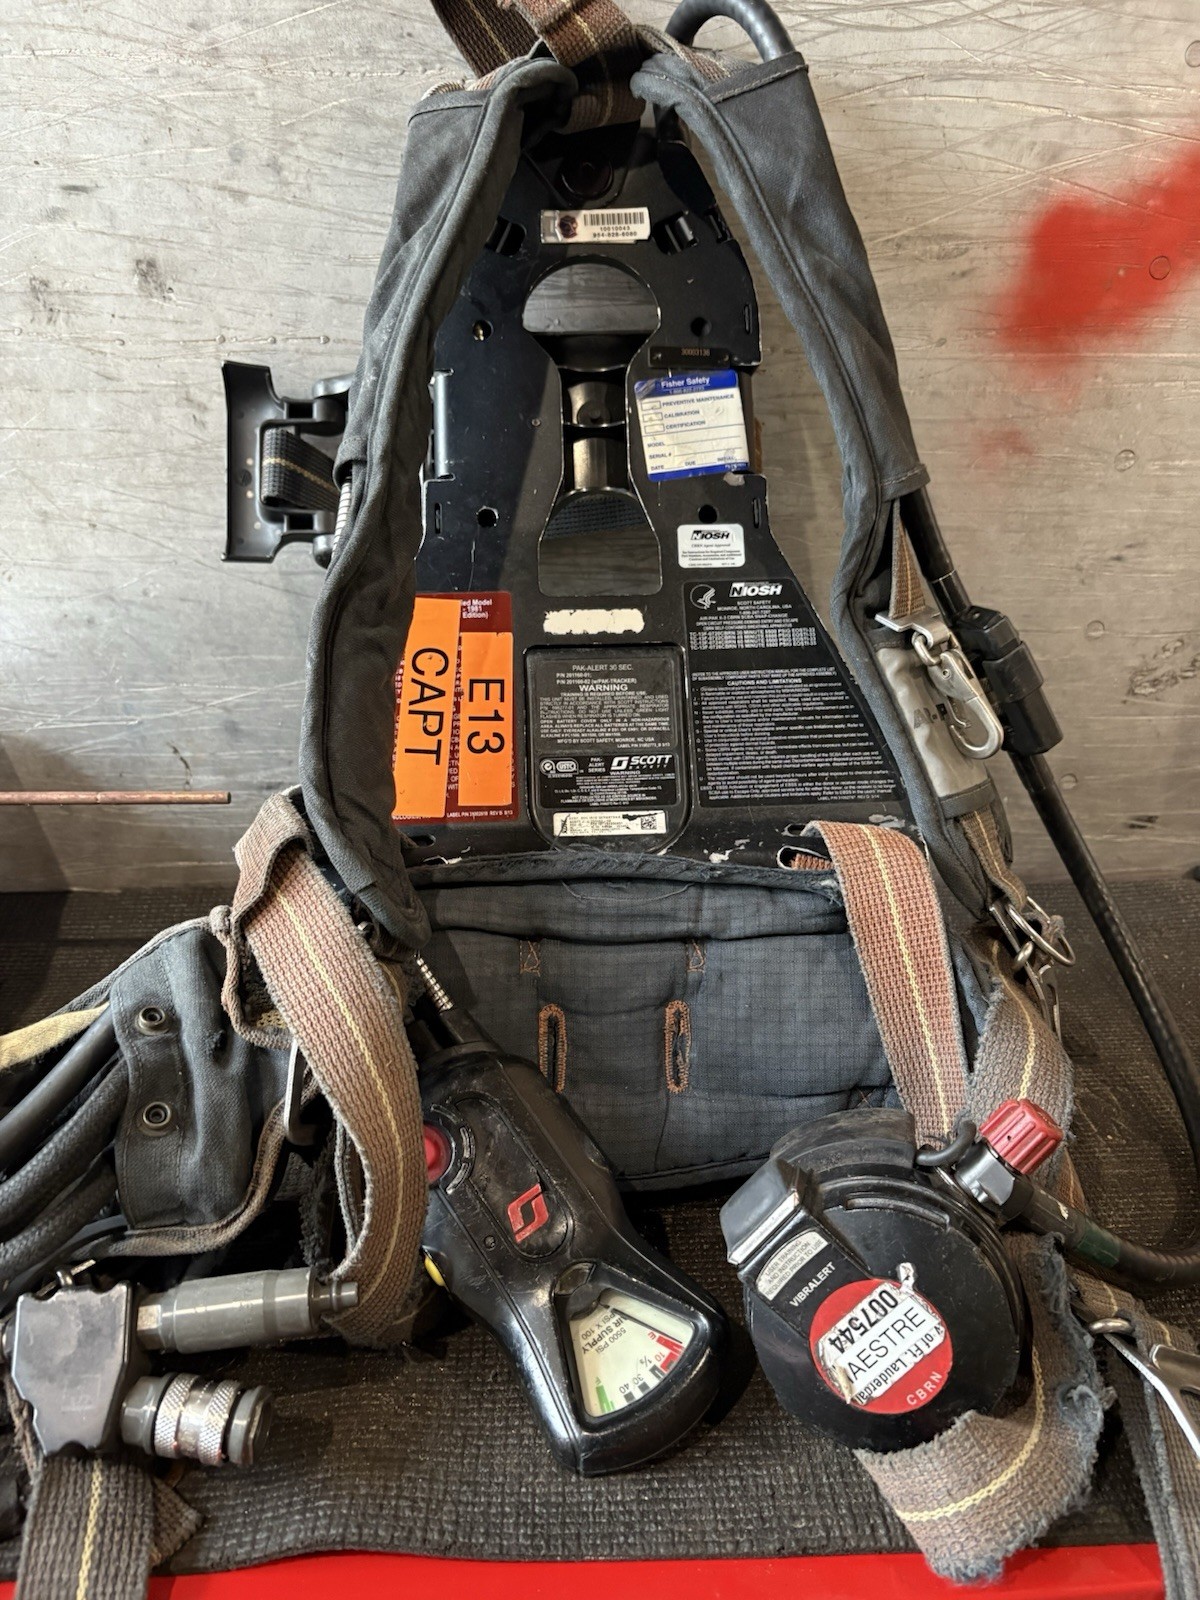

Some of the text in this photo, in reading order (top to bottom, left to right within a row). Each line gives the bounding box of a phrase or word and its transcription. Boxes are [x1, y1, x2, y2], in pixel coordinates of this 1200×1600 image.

[661, 376, 710, 388] Fisher Safety
[662, 394, 735, 407] PREVENTIVE MAINTENANCE
[664, 410, 700, 419] CALIBRATION
[666, 421, 706, 430] CERTIFICATION
[691, 530, 730, 540] NIOSH
[729, 582, 782, 597] NIOSH
[404, 648, 449, 766] CAPT
[467, 679, 505, 754] E13
[630, 755, 672, 765] SCOTT
[765, 1240, 824, 1297] REQUIRED PRIOR TO USE
[766, 1260, 779, 1276] USER
[768, 1274, 779, 1285] AND
[789, 1262, 836, 1307] VIBRALERT
[829, 1290, 899, 1354] 007544
[581, 1328, 595, 1340] 100
[582, 1326, 614, 1354] SUPPLY
[596, 1327, 626, 1354] 5500 PSI
[647, 1331, 656, 1340] E
[922, 1333, 934, 1349] of
[848, 1306, 926, 1384] AESTRE
[904, 1342, 925, 1359] Ft.
[655, 1352, 666, 1362] 10
[633, 1374, 644, 1386] 30
[619, 1383, 630, 1394] 40
[906, 1371, 943, 1405] CBRN
